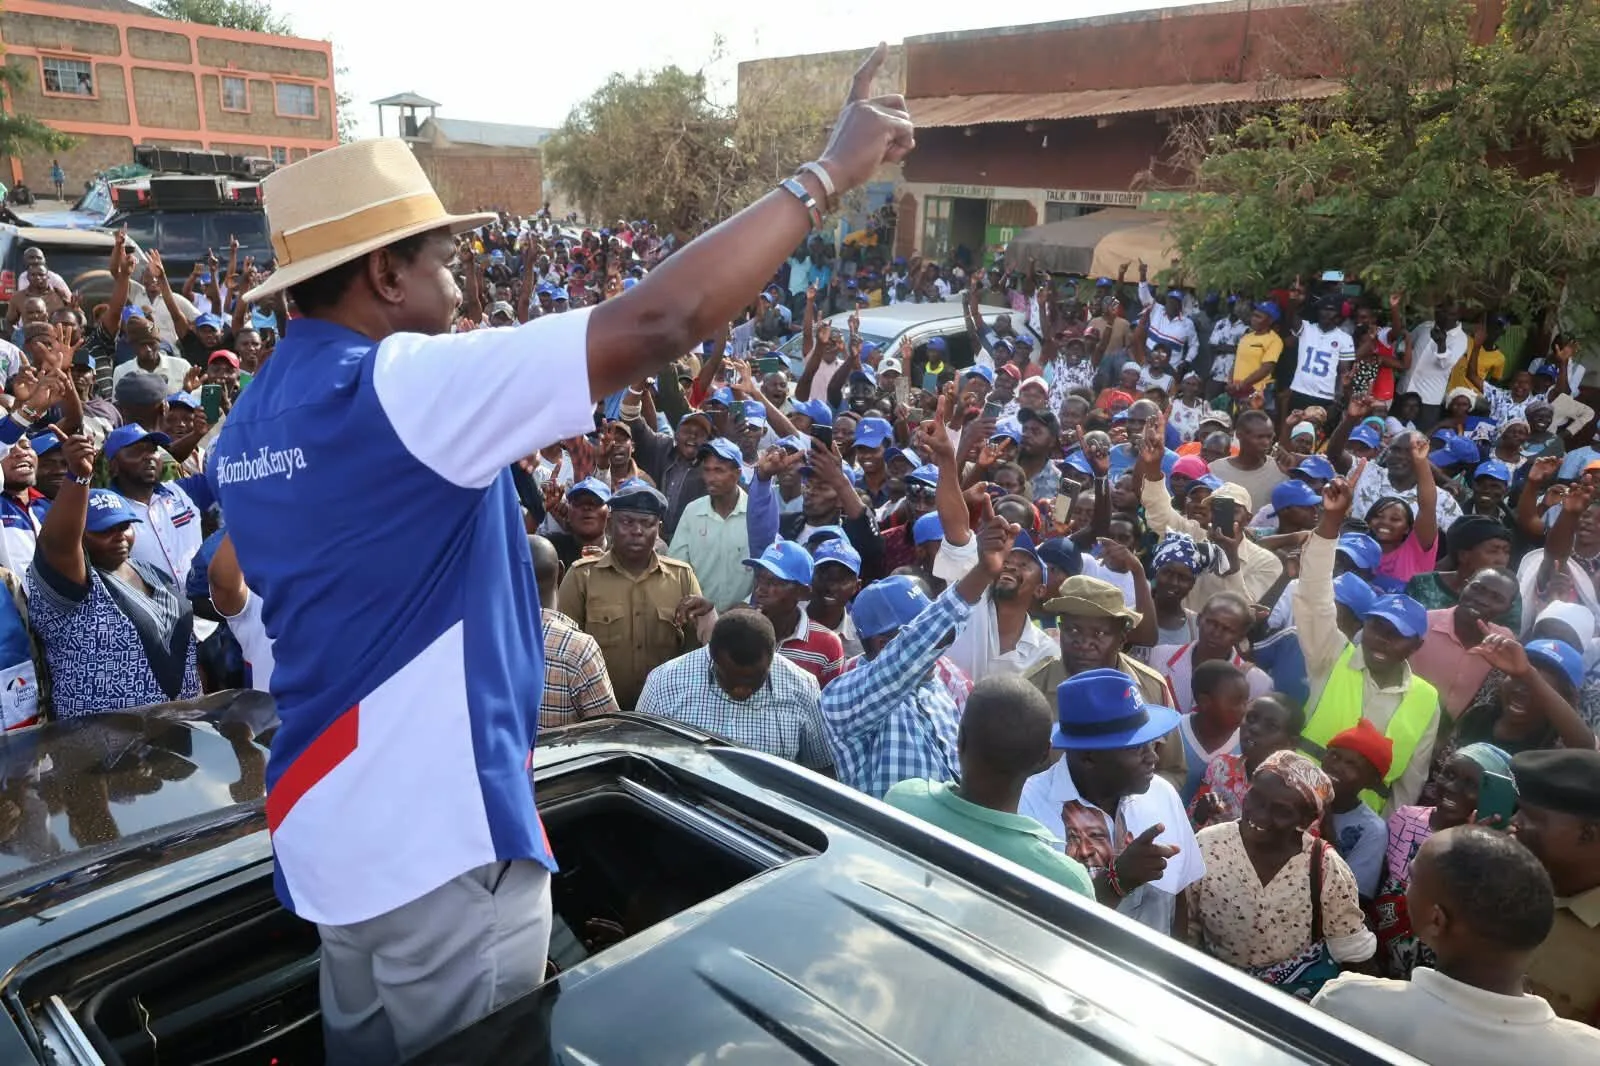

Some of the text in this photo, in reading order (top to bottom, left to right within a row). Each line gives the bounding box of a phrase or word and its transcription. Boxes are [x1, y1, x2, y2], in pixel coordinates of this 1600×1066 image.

[1046, 191, 1066, 201] TALK
[1069, 192, 1077, 201] IN
[1080, 192, 1102, 202] TOWN
[1301, 345, 1332, 377] 15
[216, 446, 307, 488] #KomboaKenya
